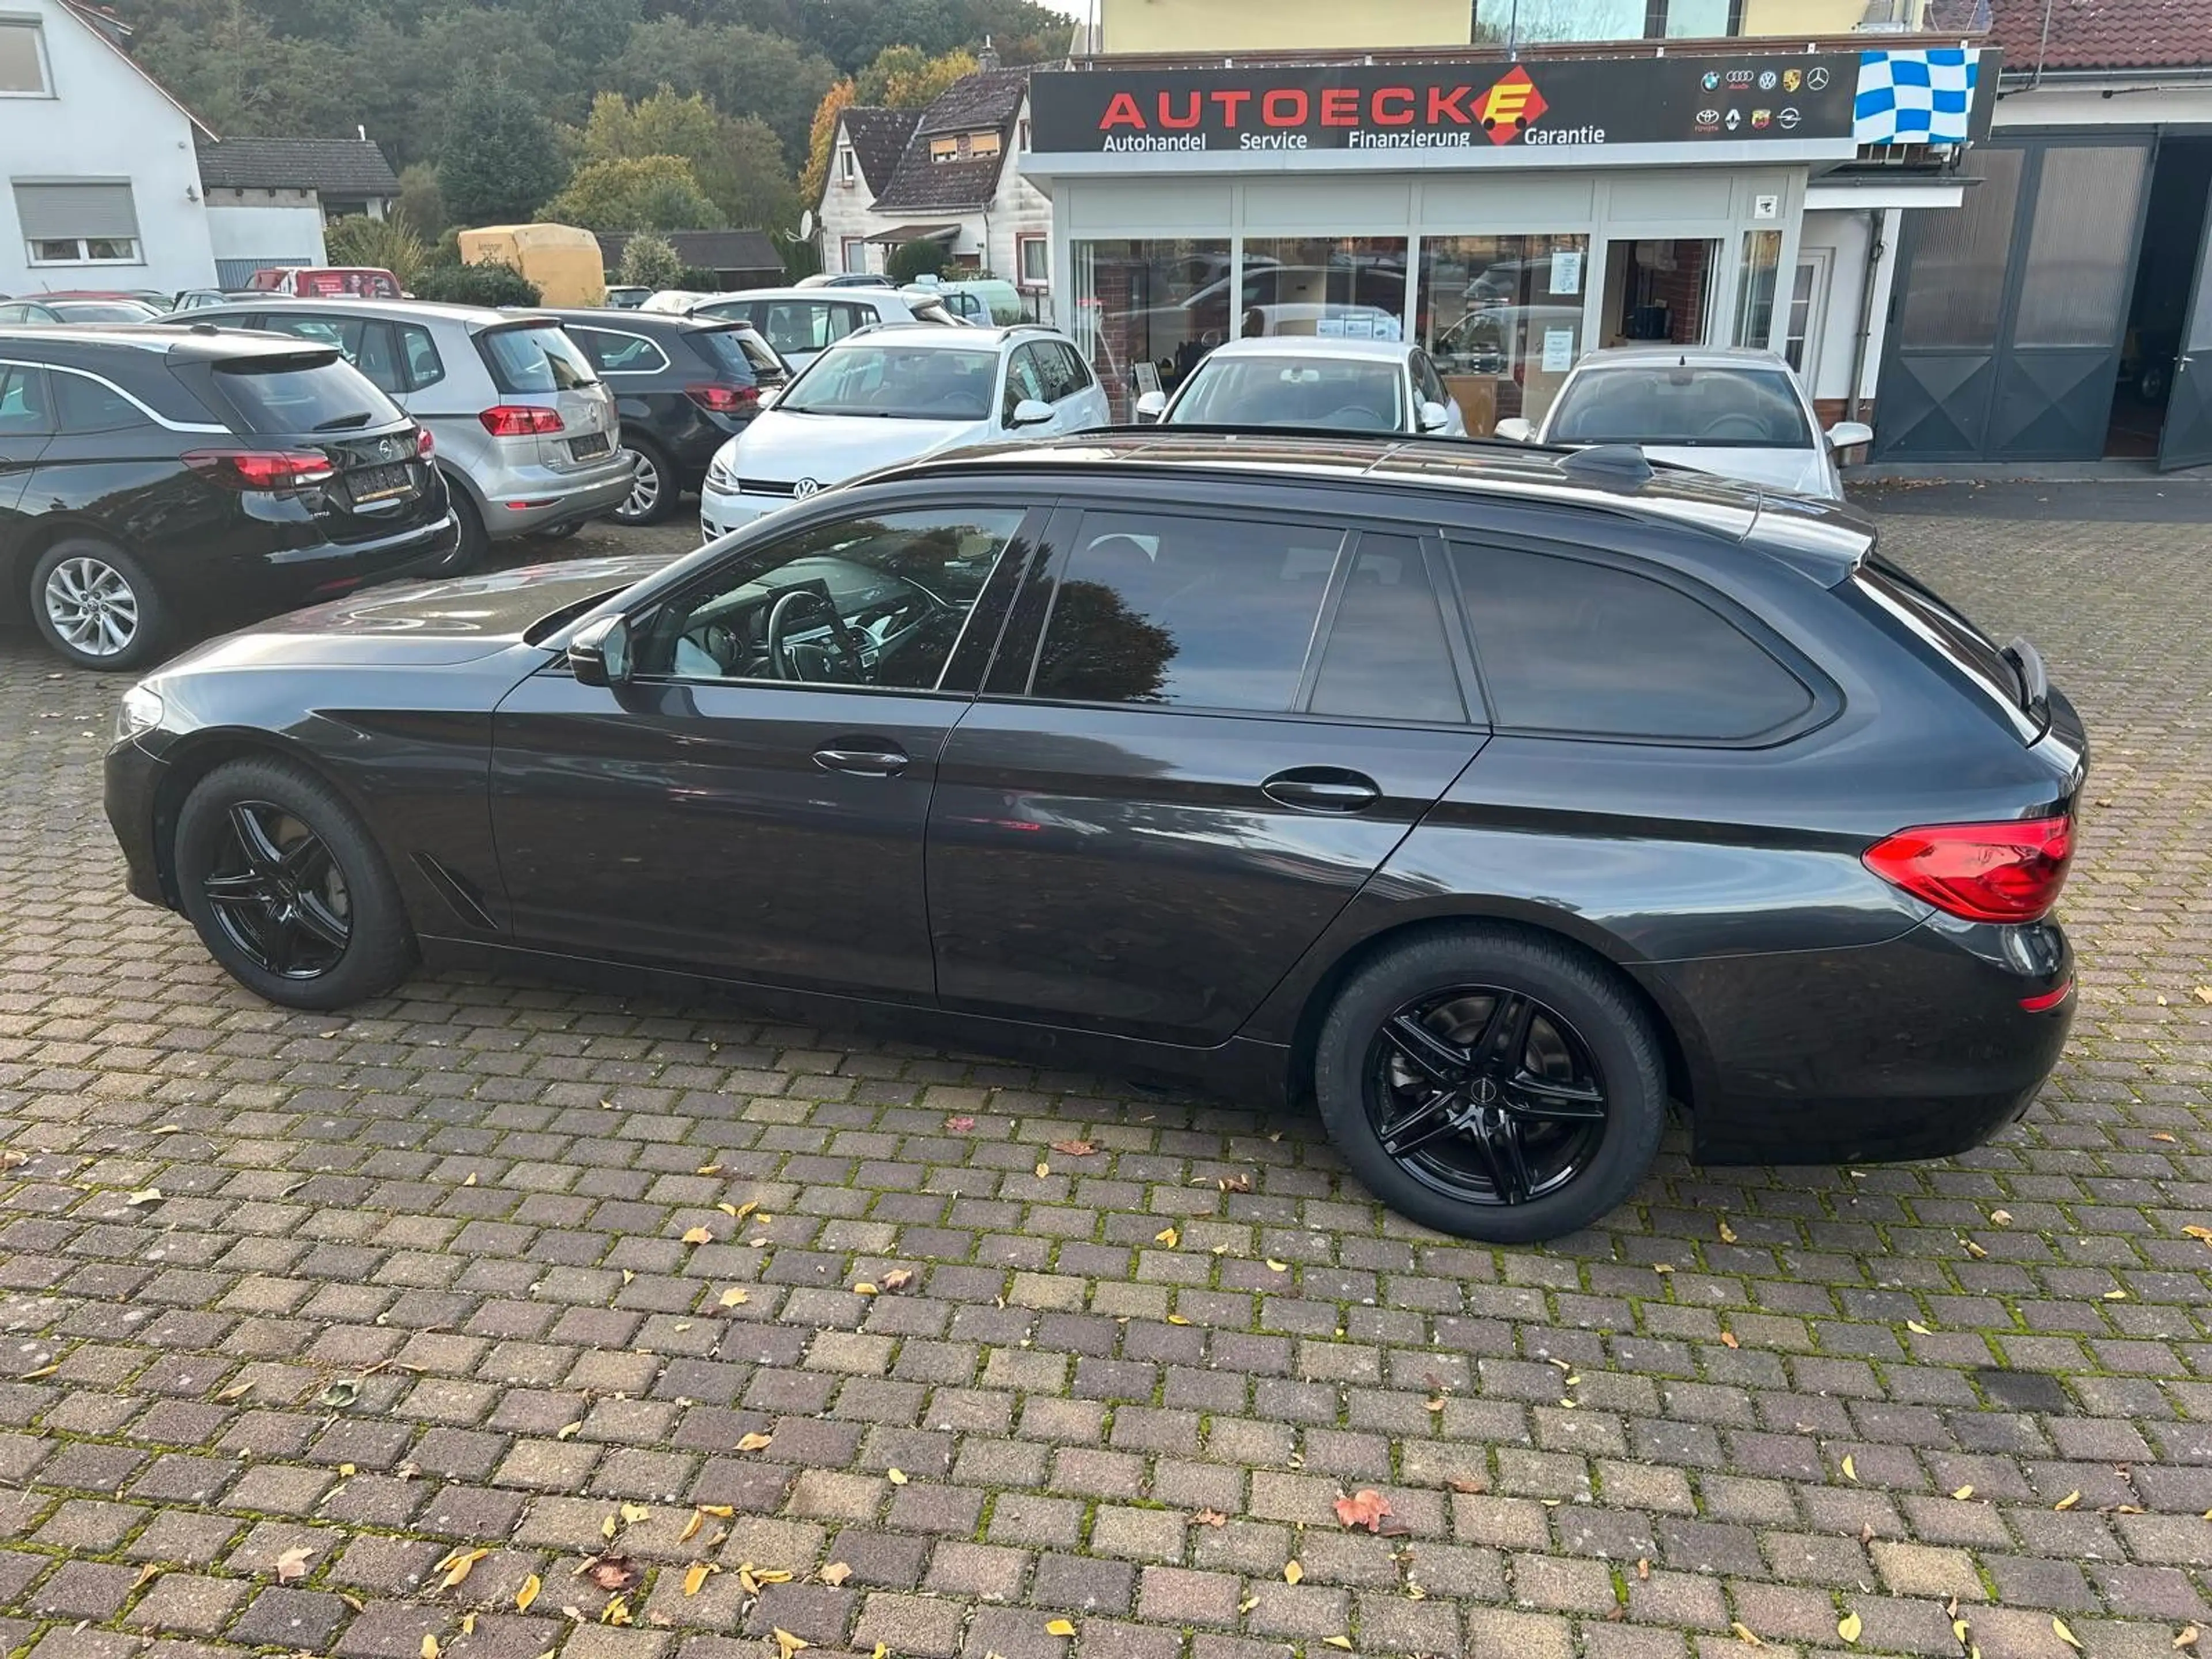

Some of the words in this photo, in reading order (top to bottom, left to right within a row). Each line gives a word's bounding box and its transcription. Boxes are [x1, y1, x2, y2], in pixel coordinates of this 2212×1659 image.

[1099, 86, 1472, 130] AUTOECK
[1103, 132, 1206, 152] Autohandel
[1240, 131, 1308, 150] Service
[1349, 128, 1471, 148] Finanzierung
[1524, 125, 1605, 146] Garantie
